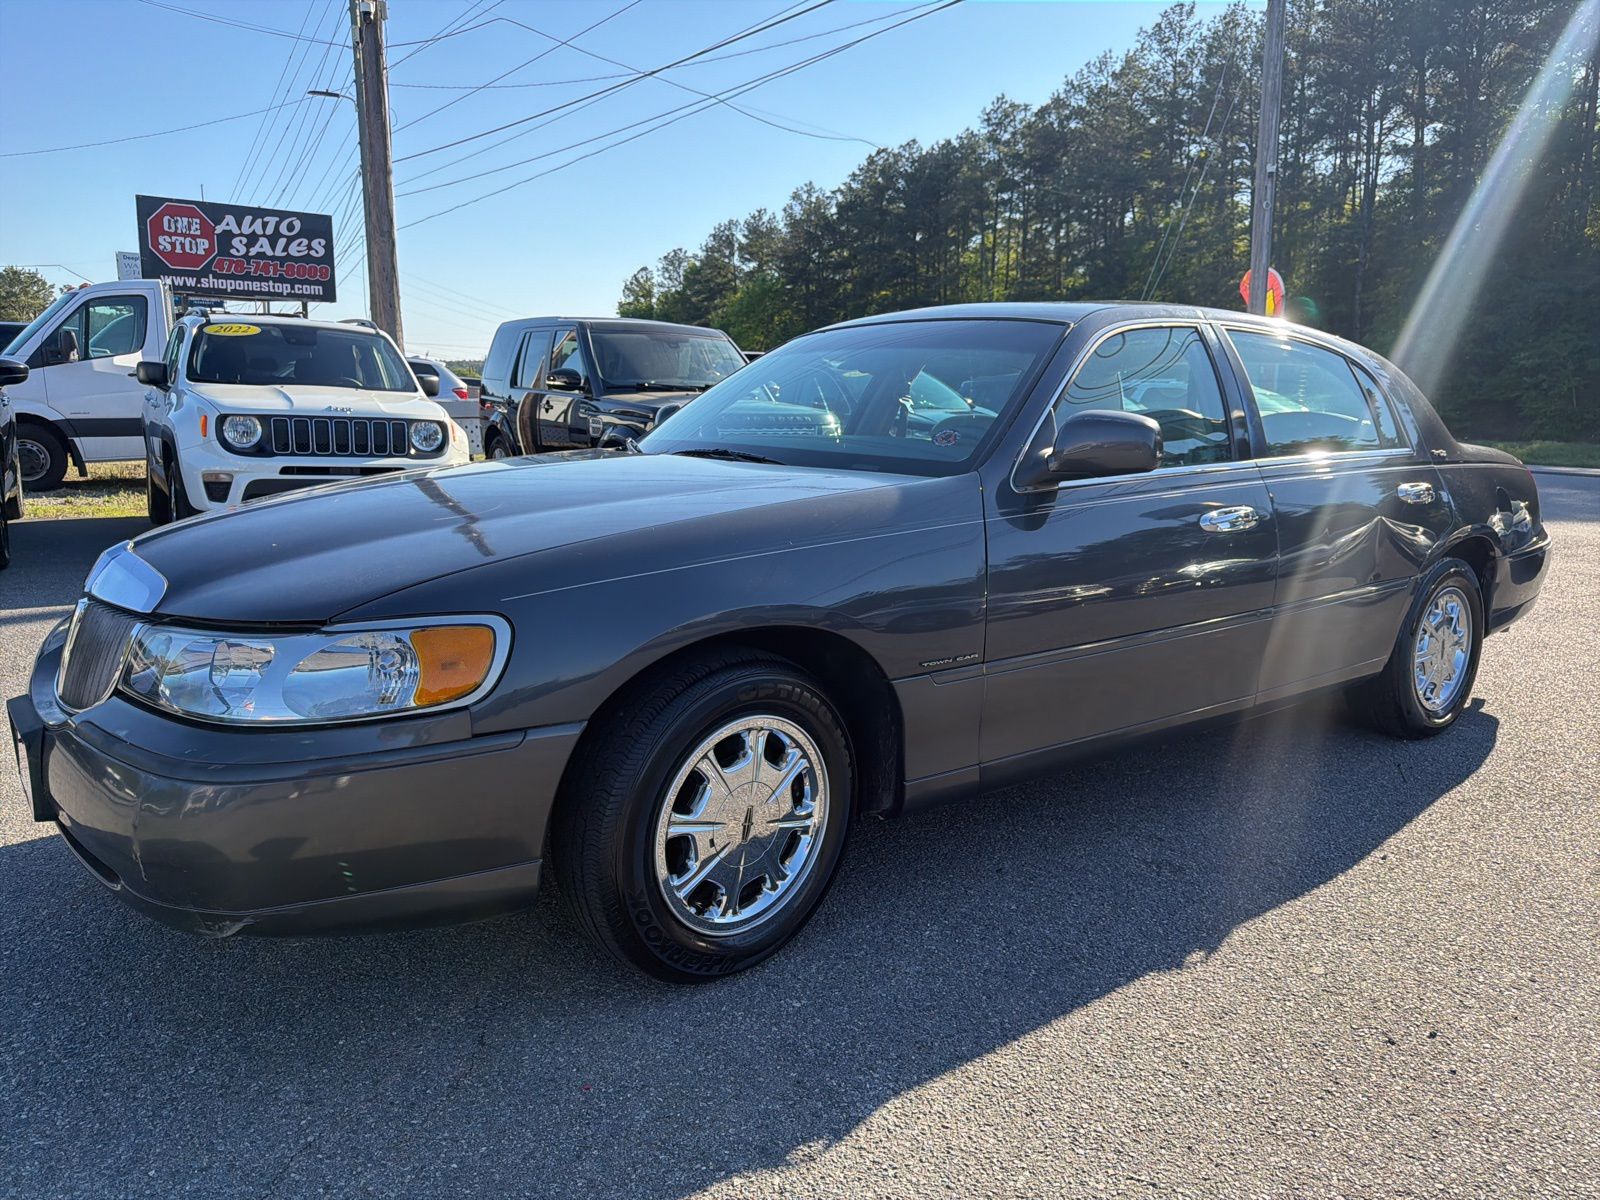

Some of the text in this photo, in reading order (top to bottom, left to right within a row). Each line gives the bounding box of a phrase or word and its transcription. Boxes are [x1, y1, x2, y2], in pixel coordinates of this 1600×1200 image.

[163, 215, 200, 235] ONE
[214, 214, 301, 236] AUTO
[158, 235, 209, 255] STOP
[229, 236, 326, 257] SALES
[212, 256, 330, 281] 478-741-8009
[160, 274, 323, 296] www.shoponestop.com
[213, 325, 251, 333] 2022
[921, 653, 979, 667] TOWN CAR
